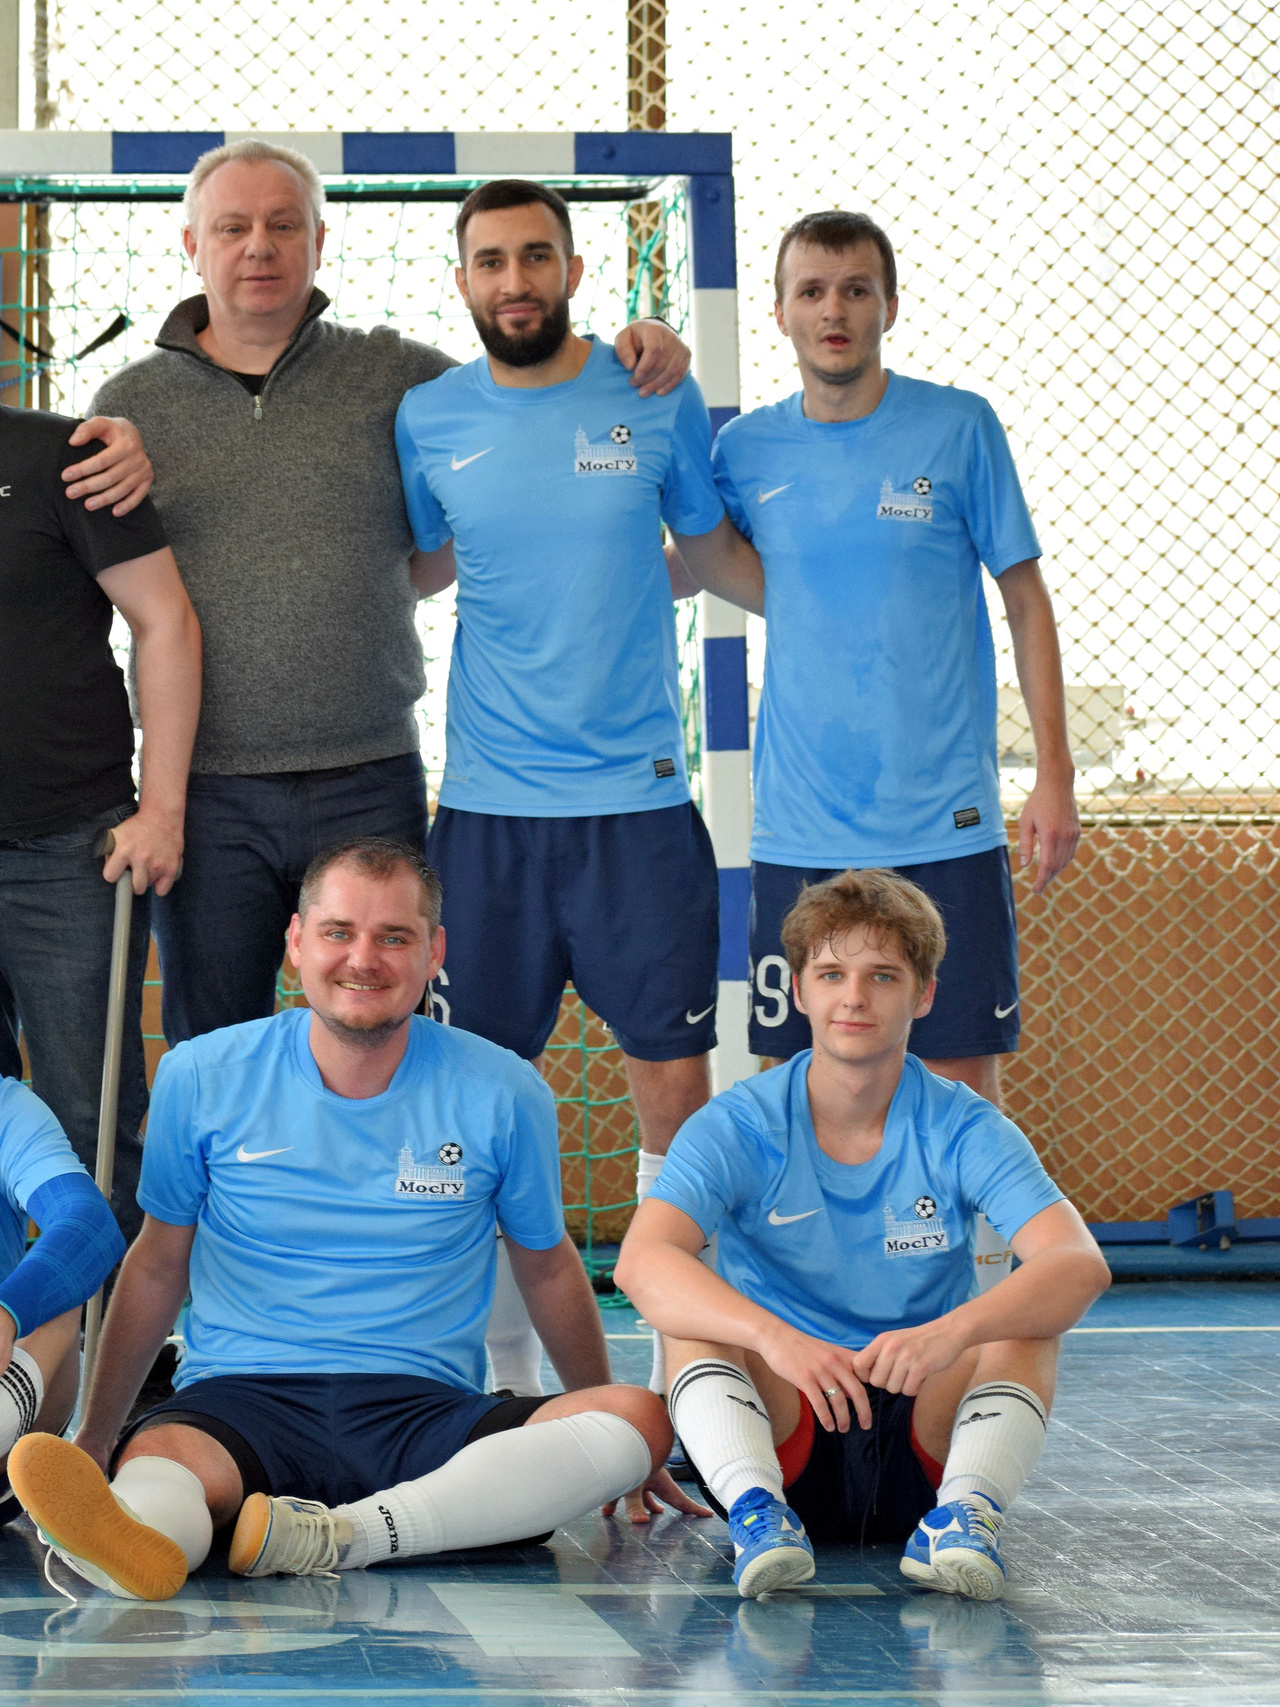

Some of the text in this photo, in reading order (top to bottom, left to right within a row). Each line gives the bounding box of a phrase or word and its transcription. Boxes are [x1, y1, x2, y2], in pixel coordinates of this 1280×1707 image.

[578, 459, 635, 472] МосГУ
[880, 506, 931, 518] МосГУ
[398, 1180, 464, 1195] МосГУ
[886, 1233, 945, 1253] МосГУ
